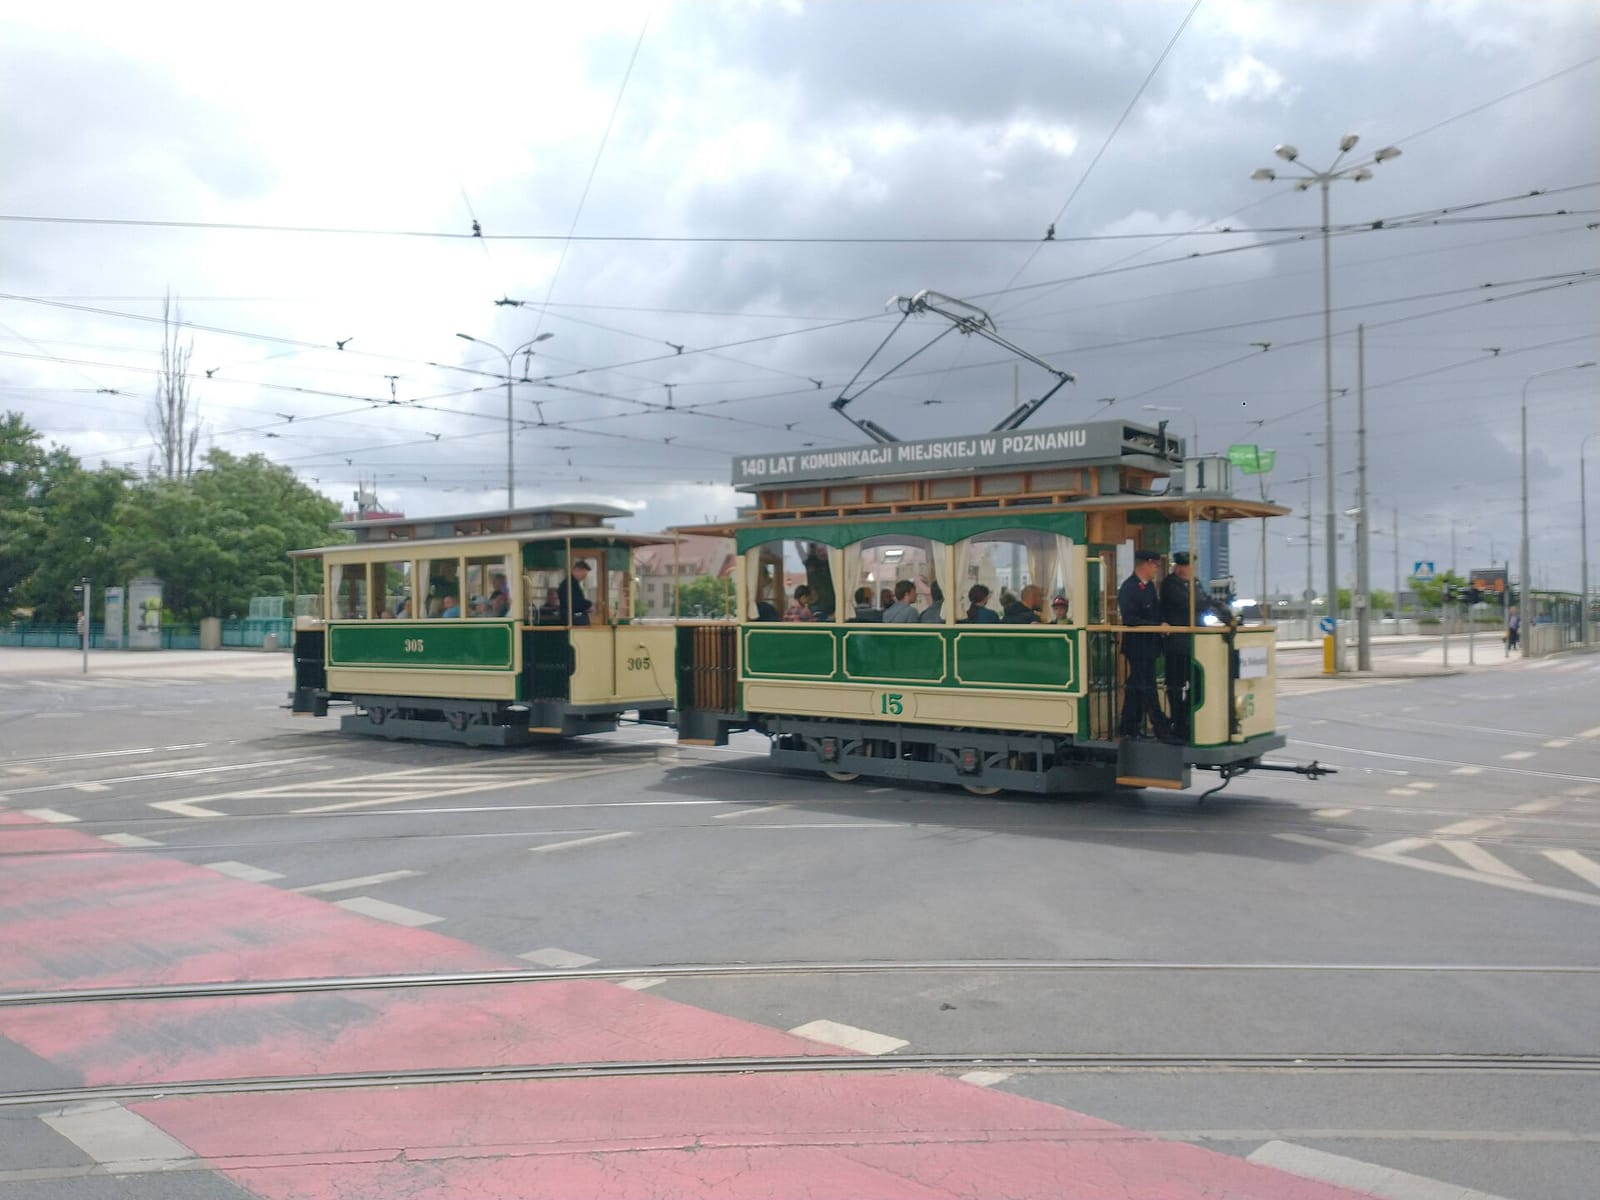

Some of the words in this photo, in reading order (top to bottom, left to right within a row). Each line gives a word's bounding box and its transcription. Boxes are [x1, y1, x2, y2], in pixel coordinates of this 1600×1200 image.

[741, 458, 766, 476] 140
[769, 456, 795, 475] LAT
[800, 452, 893, 471] KOMUNIKACJI
[897, 442, 977, 462] MIEJSKIEJ
[980, 439, 996, 456] W
[1002, 429, 1087, 454] POZNANIU
[1195, 459, 1206, 489] 1
[404, 639, 424, 653] 305
[627, 657, 651, 671] 305
[881, 693, 904, 716] 15
